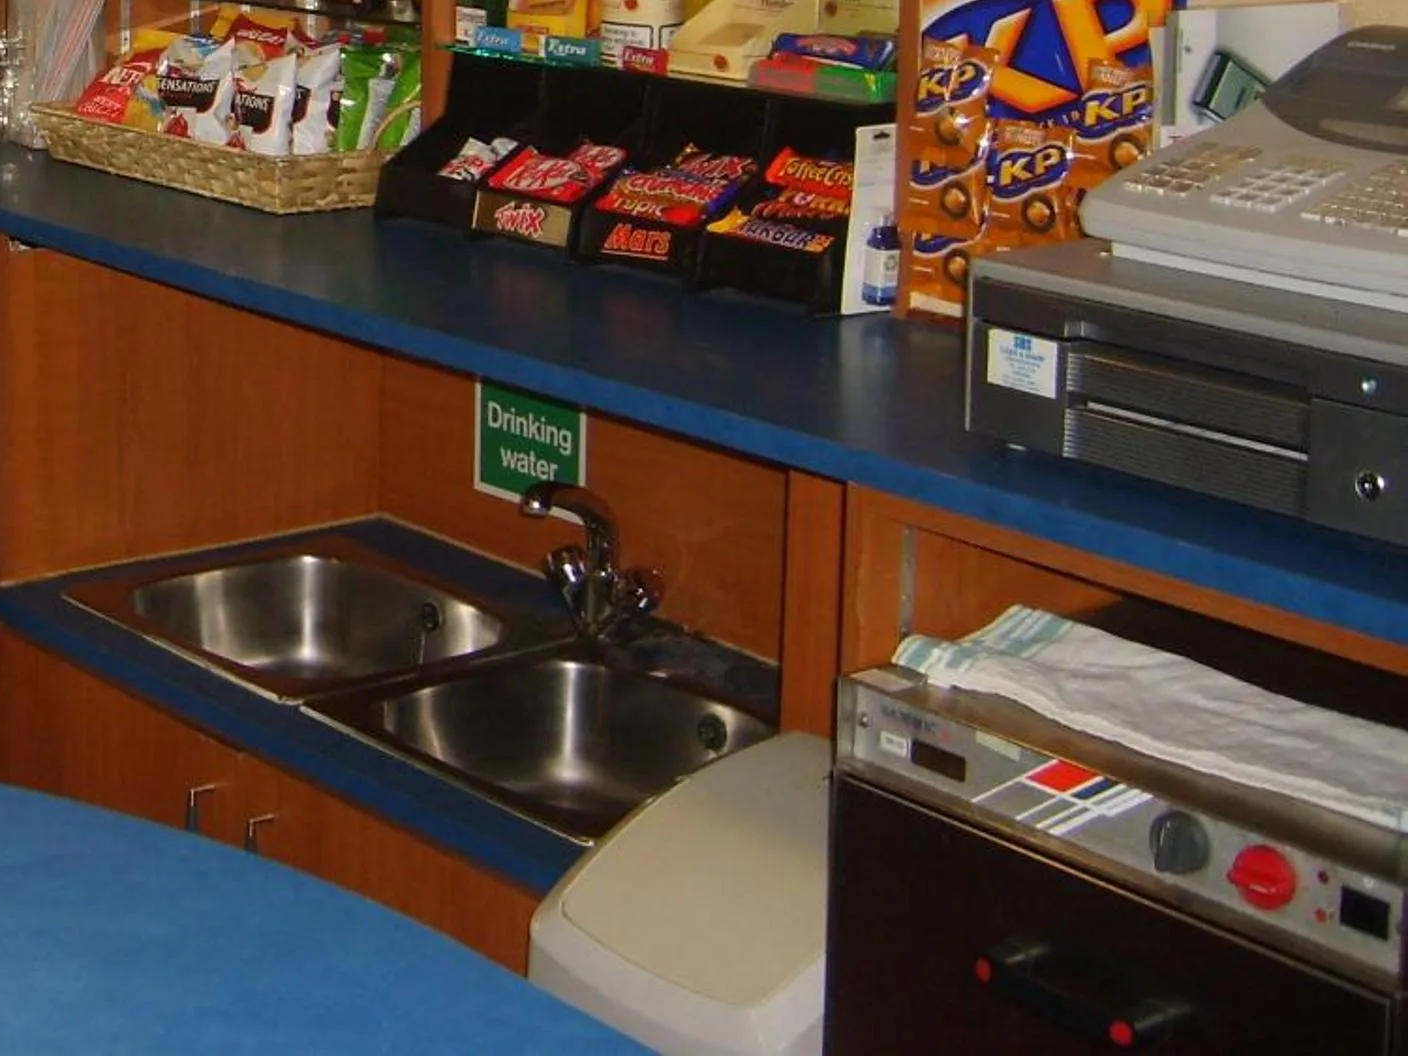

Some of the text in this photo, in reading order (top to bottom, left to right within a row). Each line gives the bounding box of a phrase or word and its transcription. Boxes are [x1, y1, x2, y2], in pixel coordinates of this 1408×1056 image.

[547, 38, 587, 56] Extra
[918, 62, 978, 103] KP
[1086, 87, 1147, 128] KP
[998, 146, 1062, 181] KP
[495, 200, 545, 239] Twix
[603, 223, 672, 256] Mars
[487, 401, 572, 456] Drinking
[500, 446, 559, 482] water
